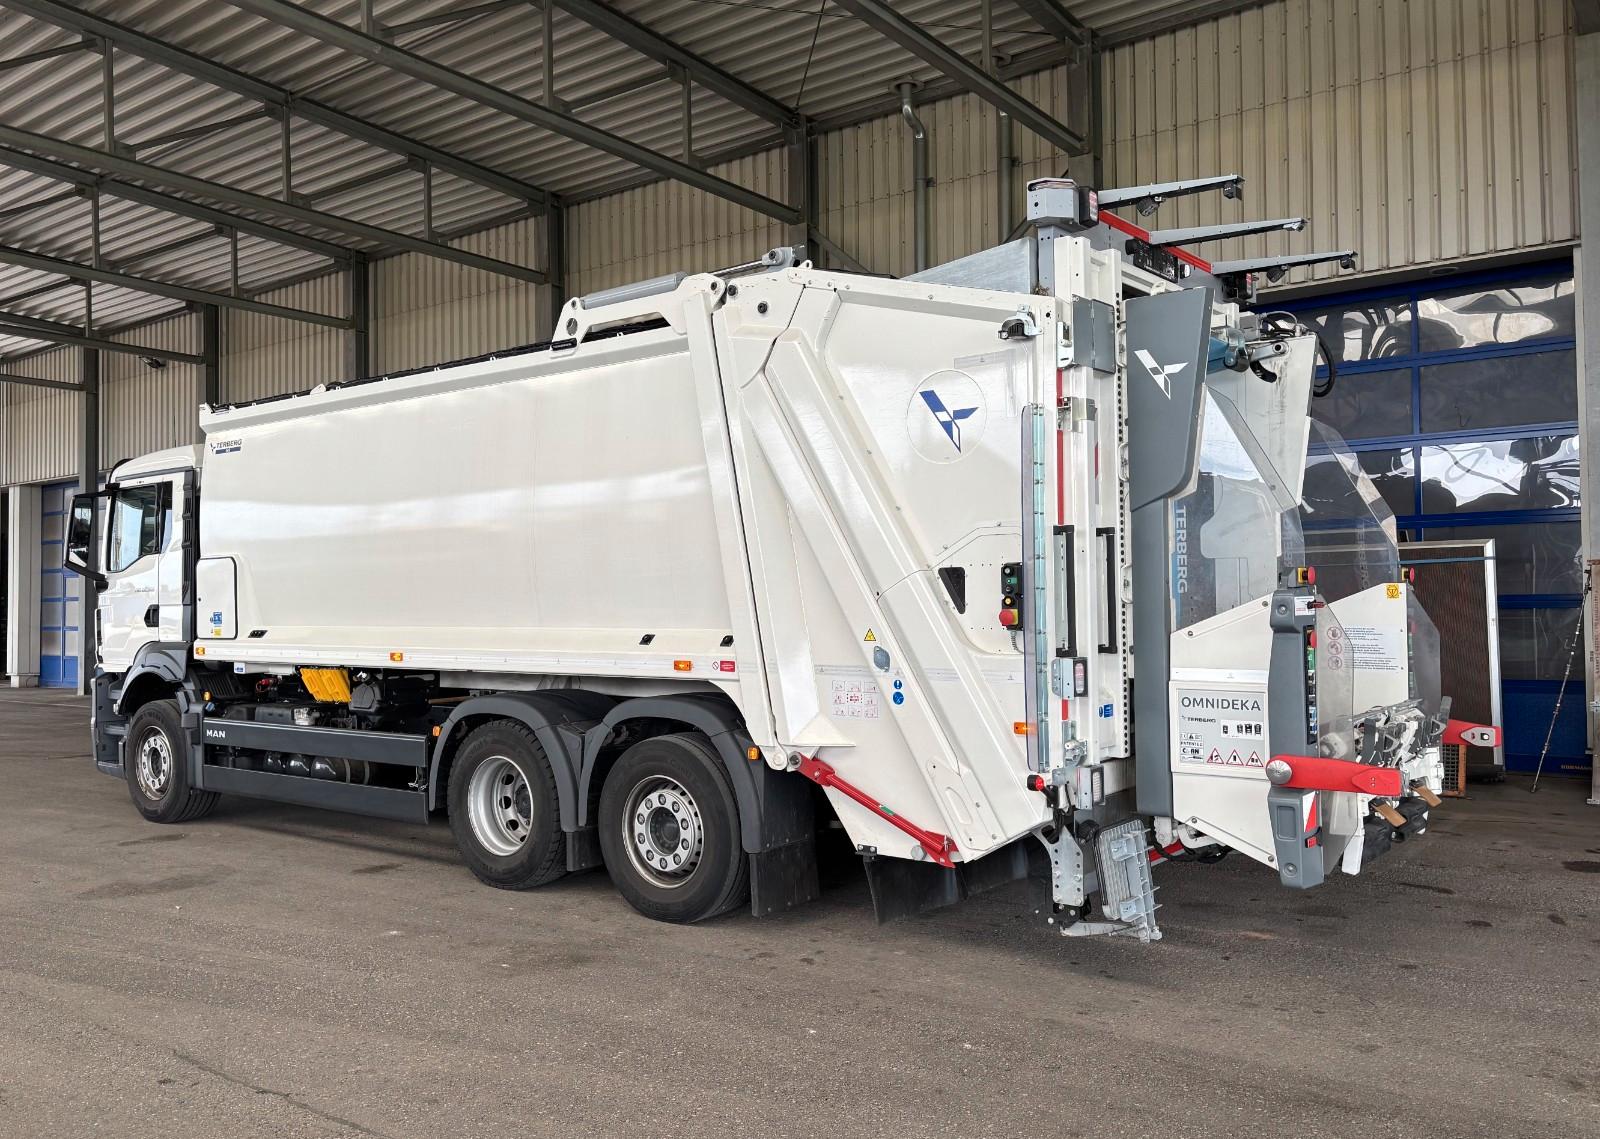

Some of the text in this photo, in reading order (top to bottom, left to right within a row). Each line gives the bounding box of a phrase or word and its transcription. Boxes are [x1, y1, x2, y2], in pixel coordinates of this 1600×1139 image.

[216, 438, 242, 448] TERBERG
[1175, 505, 1188, 594] TERBERG
[1181, 696, 1261, 711] OMNIDEKA
[206, 729, 226, 739] MAN
